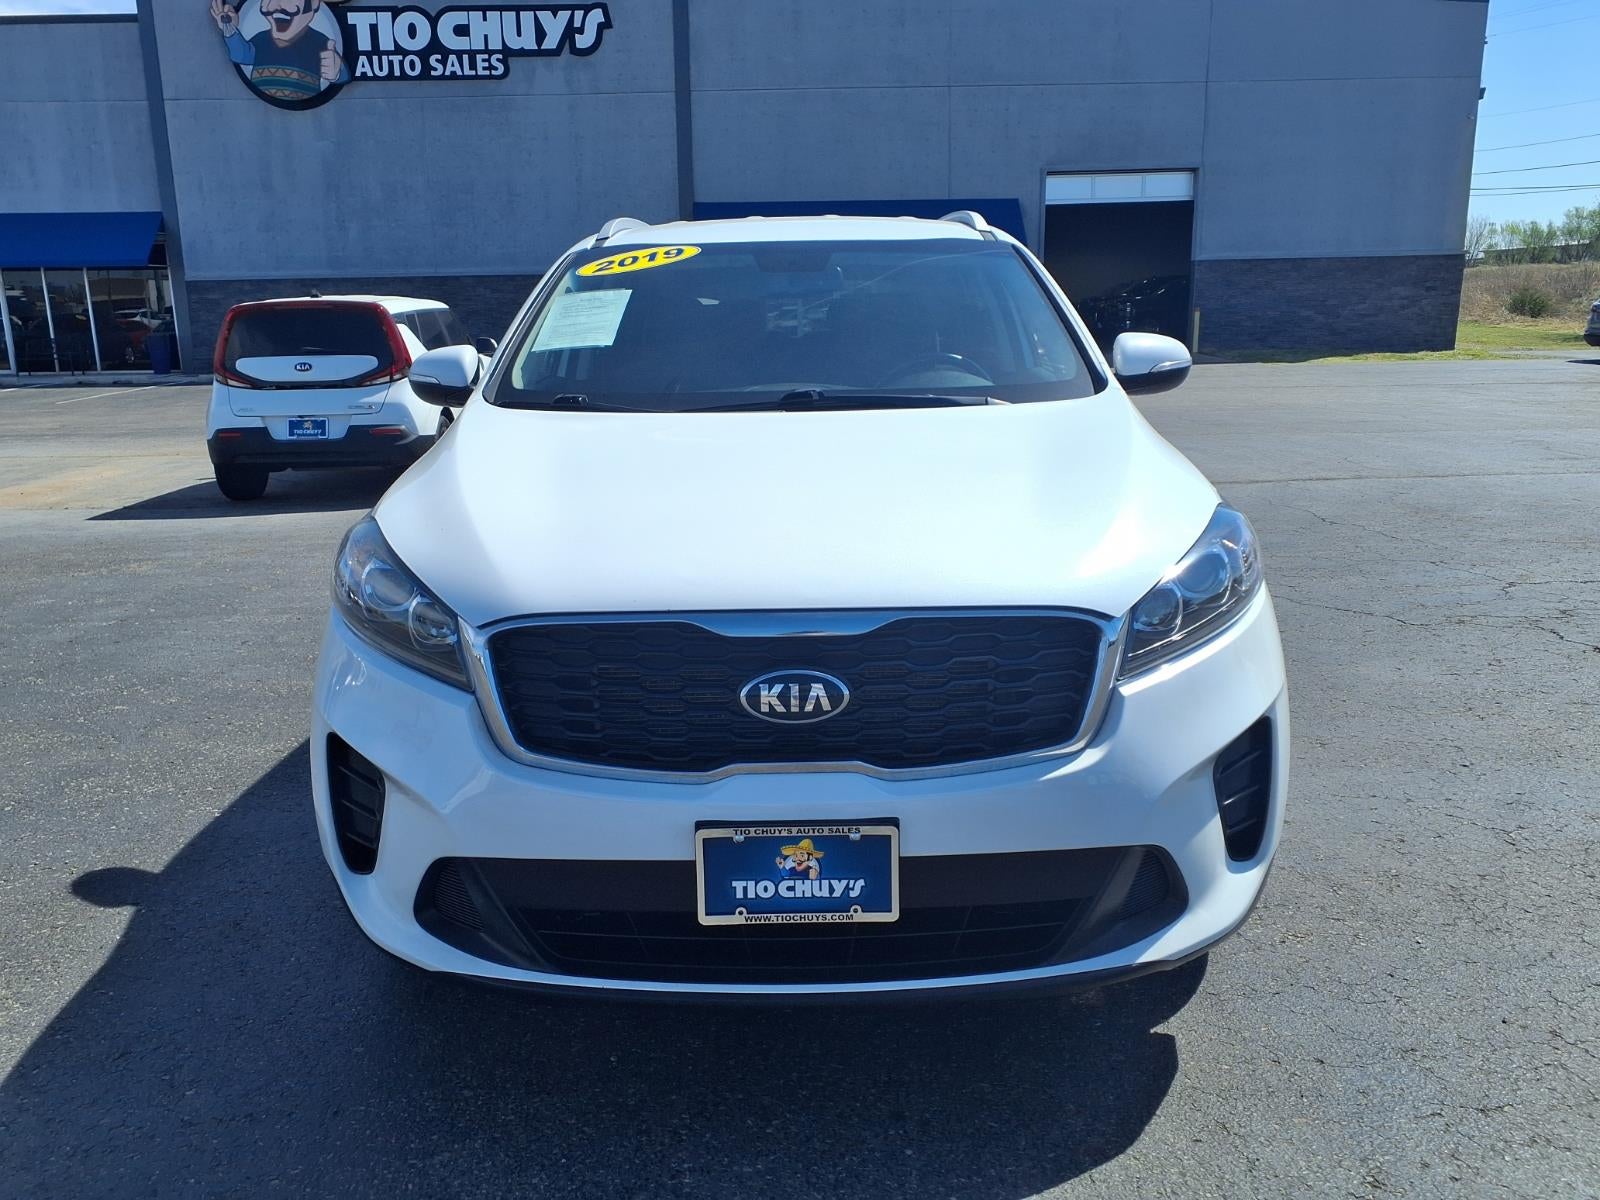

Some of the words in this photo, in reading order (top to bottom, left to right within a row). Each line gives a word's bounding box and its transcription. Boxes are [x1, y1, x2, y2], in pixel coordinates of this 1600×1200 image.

[347, 11, 432, 51] TIO
[437, 8, 605, 50] CHUY'S
[354, 55, 422, 77] AUTO
[429, 53, 505, 76] SALES
[592, 247, 685, 274] 2019
[758, 682, 832, 713] KIA
[732, 828, 751, 836] TIO
[754, 828, 793, 836] CHUY'S
[796, 827, 826, 835] AUTO
[827, 827, 861, 835] SALES
[732, 879, 776, 899] TIO
[778, 879, 866, 899] CHUY'S
[744, 914, 854, 923] WWW.TIOCHUYS.COM
